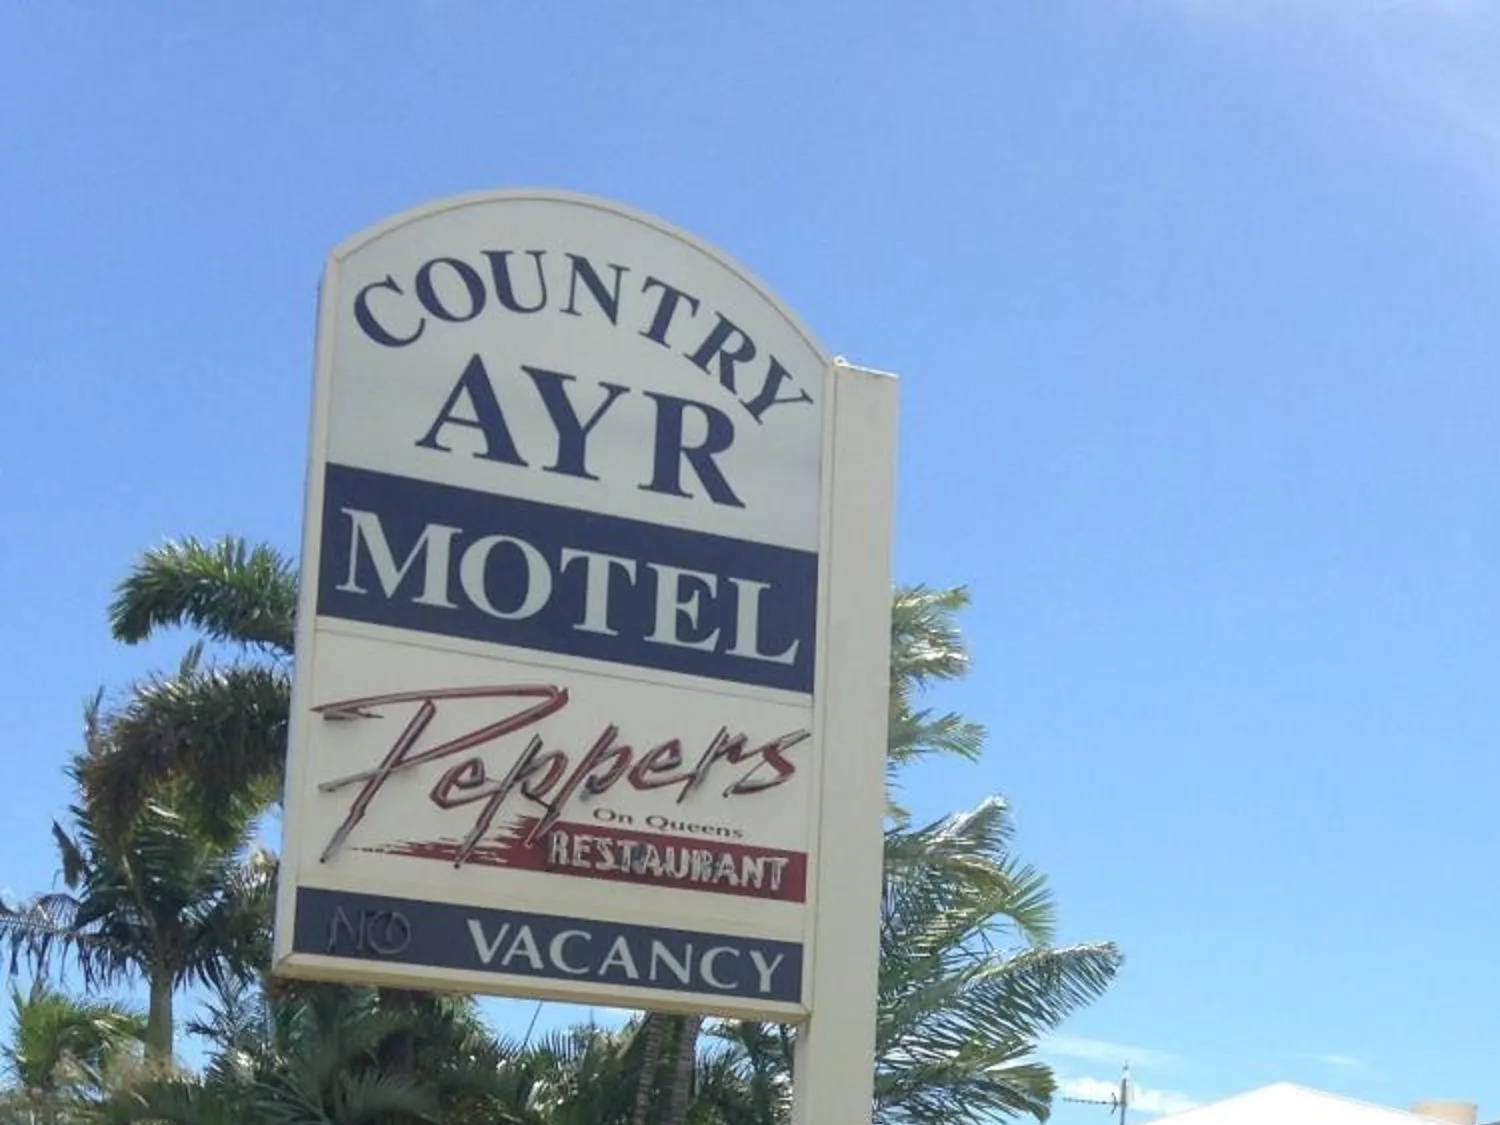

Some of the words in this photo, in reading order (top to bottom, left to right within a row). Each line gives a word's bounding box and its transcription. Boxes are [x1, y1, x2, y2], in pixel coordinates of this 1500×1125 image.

[352, 249, 814, 426] COUNTRY
[414, 352, 747, 509] AYR
[336, 507, 801, 666] MOTEL
[310, 684, 812, 870] Peppers
[592, 807, 634, 824] On
[645, 814, 744, 839] Queens
[549, 829, 790, 891] RESTAURANT
[467, 918, 785, 994] VACANCY
